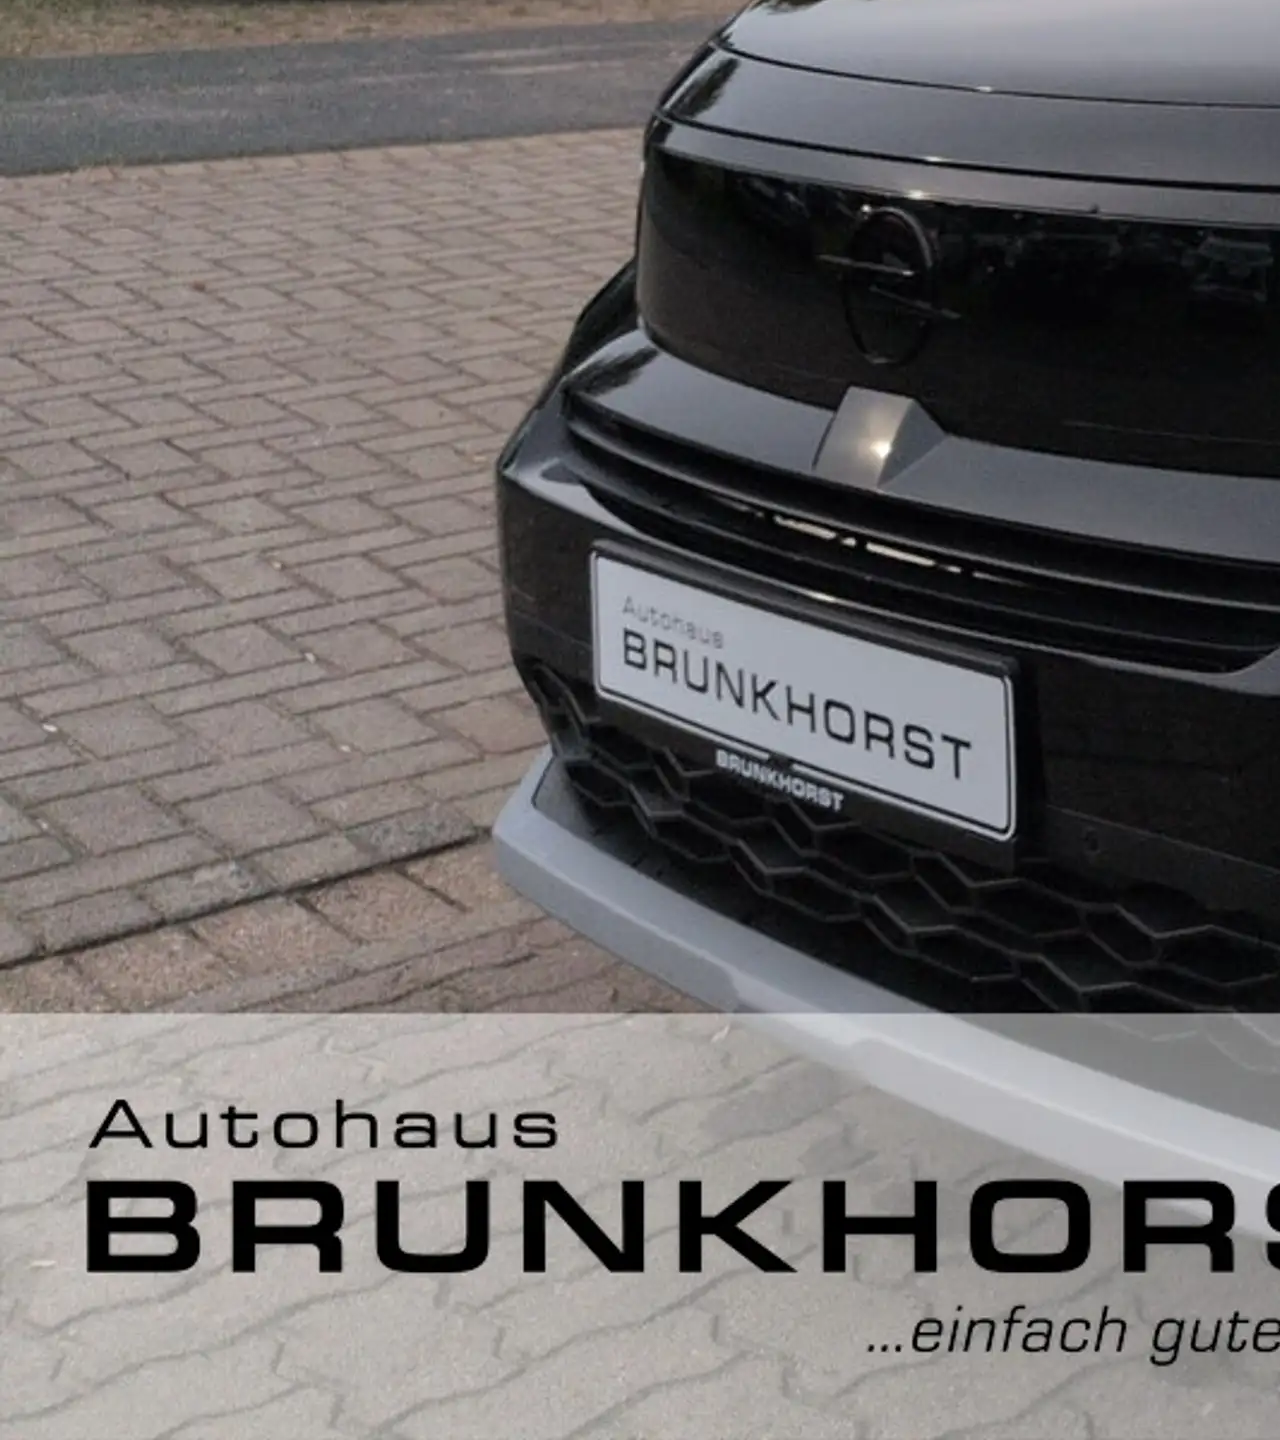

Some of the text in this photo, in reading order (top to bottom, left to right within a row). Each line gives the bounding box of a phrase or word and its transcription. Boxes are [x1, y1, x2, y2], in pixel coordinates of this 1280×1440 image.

[622, 596, 724, 650] Autohaus
[623, 627, 971, 780] BRUNKHORST
[716, 748, 844, 812] BRUNKHORST
